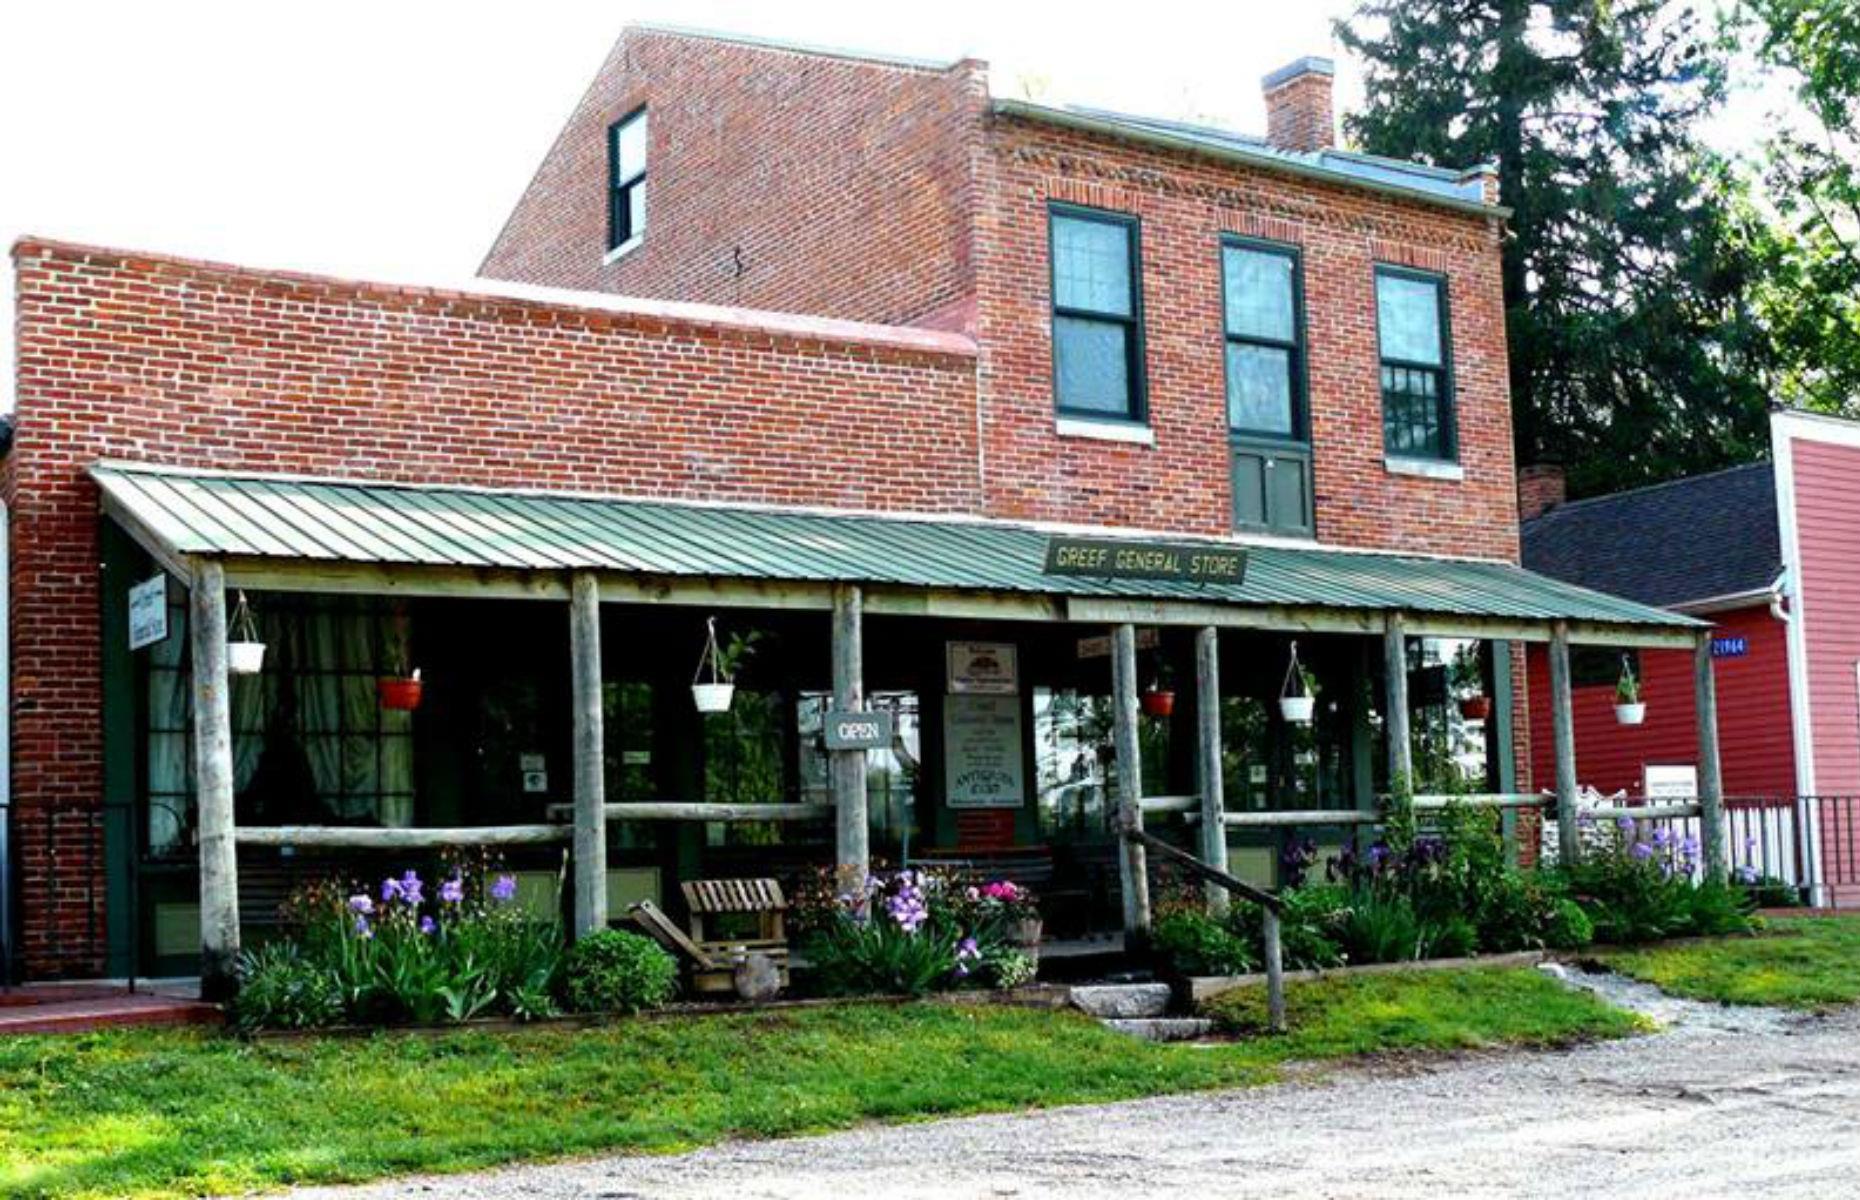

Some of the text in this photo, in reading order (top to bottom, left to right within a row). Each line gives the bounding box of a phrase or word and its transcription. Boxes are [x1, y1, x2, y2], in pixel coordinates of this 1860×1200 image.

[1056, 546, 1239, 576] GREEF GENERAL STORE
[838, 722, 880, 739] OPEN
